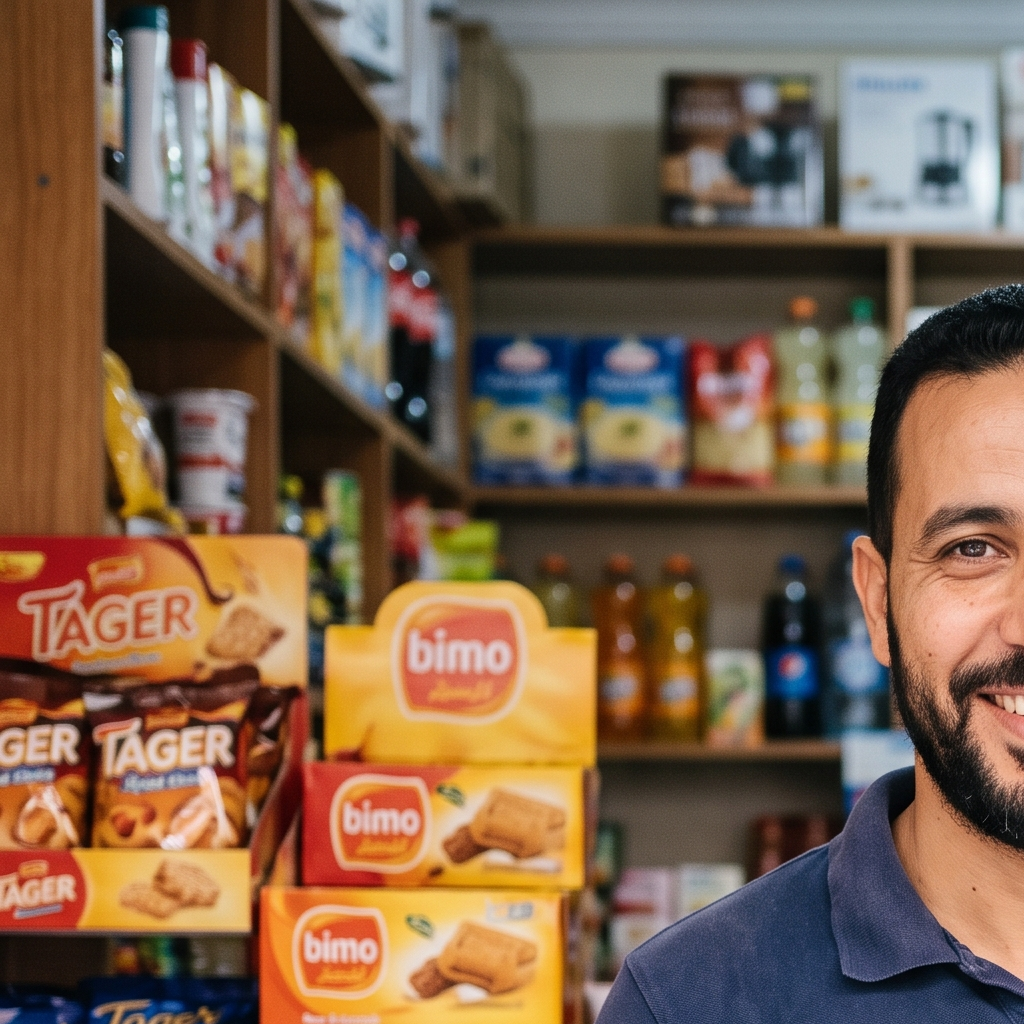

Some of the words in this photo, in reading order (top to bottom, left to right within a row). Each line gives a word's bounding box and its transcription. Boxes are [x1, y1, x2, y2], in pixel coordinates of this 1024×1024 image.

[18, 579, 199, 663] TAGER
[408, 628, 512, 675] bimo
[0, 723, 80, 765] GER
[92, 717, 235, 779] TAGER
[342, 800, 421, 837] bimo
[303, 930, 379, 965] bimo
